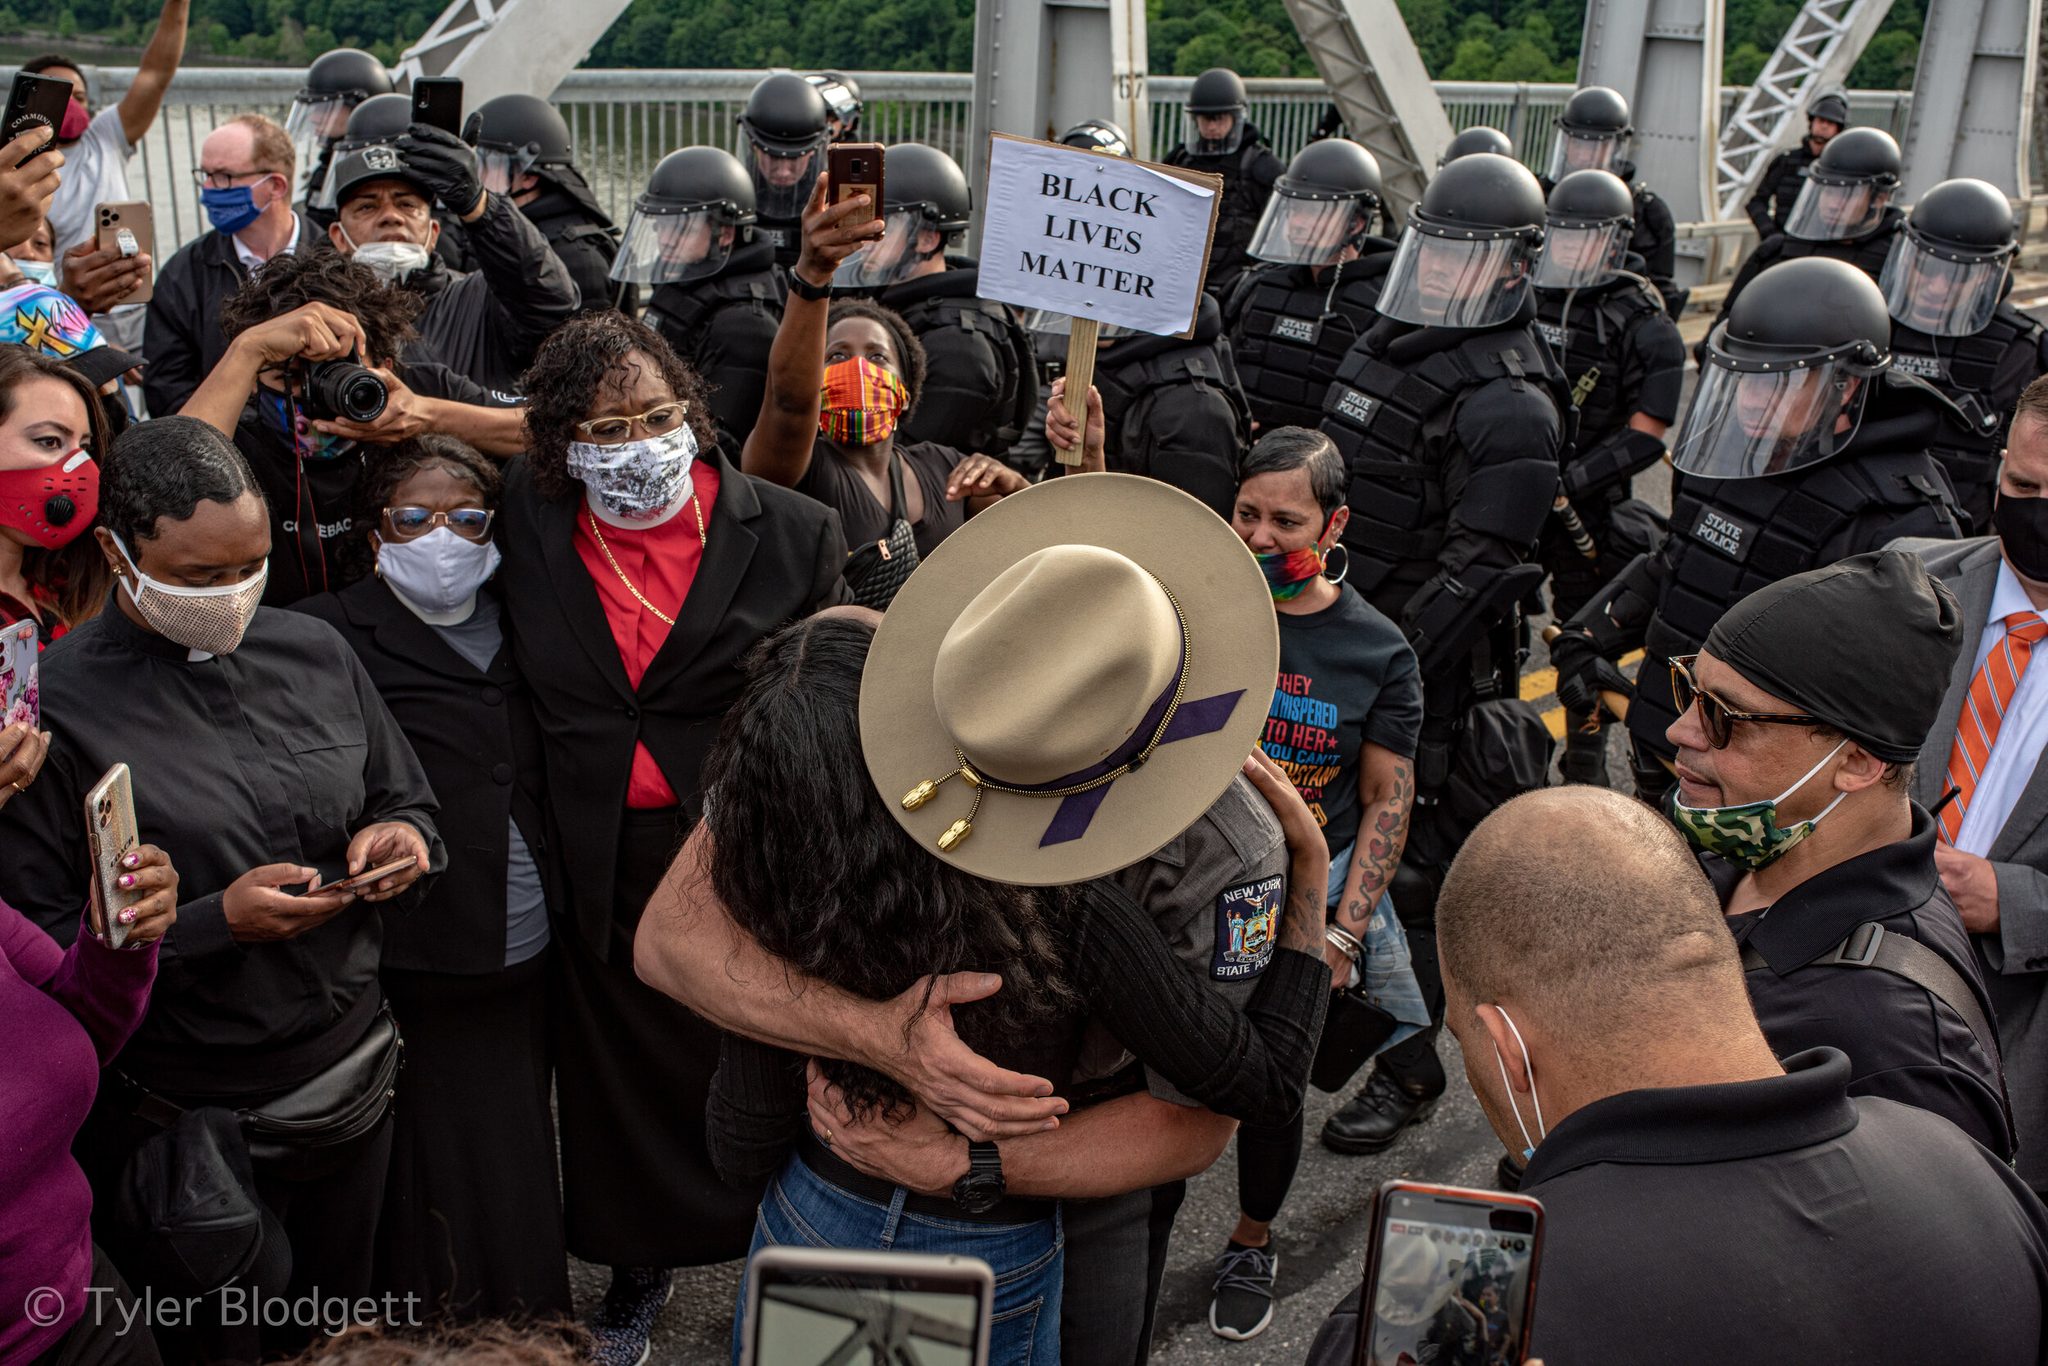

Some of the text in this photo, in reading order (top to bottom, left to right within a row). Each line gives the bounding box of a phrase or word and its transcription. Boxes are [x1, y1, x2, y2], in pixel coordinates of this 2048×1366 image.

[11, 113, 52, 128] COMMUNI
[1039, 172, 1160, 218] BLACK
[1043, 213, 1143, 255] LIVES
[1018, 250, 1155, 299] MATTER
[1276, 325, 1313, 342] POLICE
[1282, 318, 1314, 333] STATE
[1893, 363, 1940, 378] POLICE
[1898, 354, 1940, 368] STATE
[1337, 400, 1368, 422] POLICE
[1345, 391, 1372, 411] STATE
[1704, 512, 1743, 541] STATE
[1696, 523, 1740, 556] POLICE
[1266, 718, 1328, 753] TO HER
[1261, 742, 1342, 766] YOU CAN'T
[1223, 877, 1282, 904] NEW YORK
[1216, 962, 1251, 977] STATE
